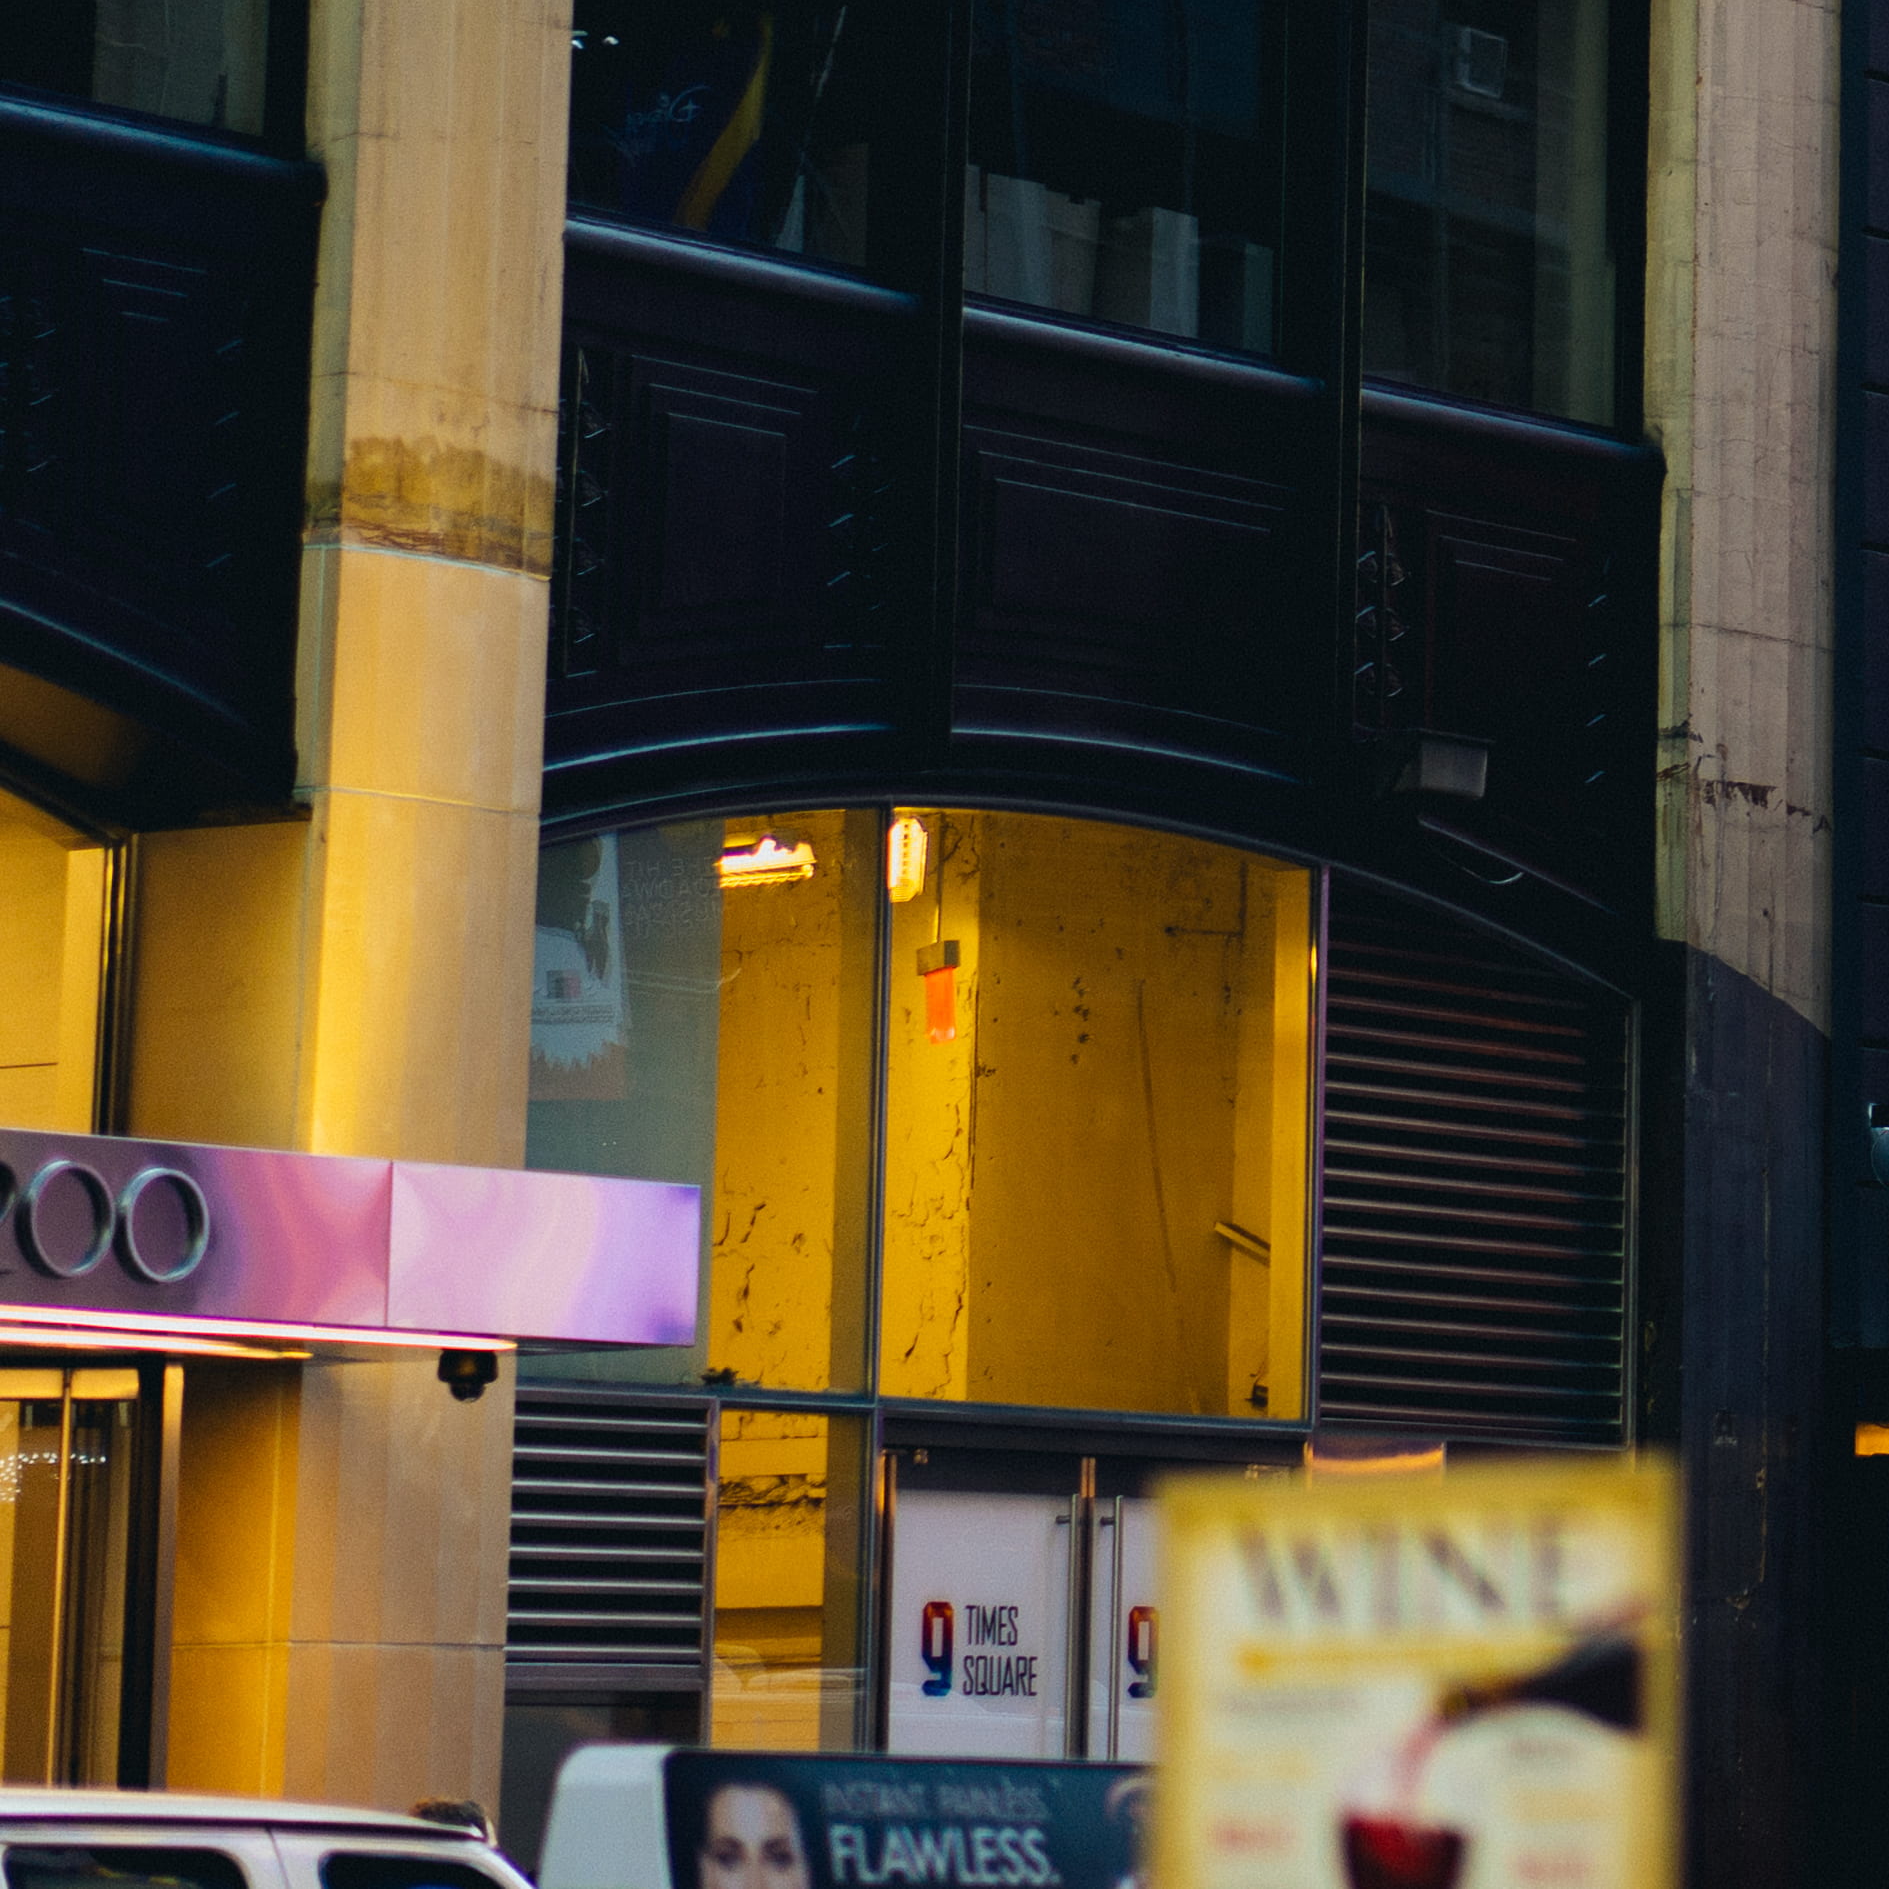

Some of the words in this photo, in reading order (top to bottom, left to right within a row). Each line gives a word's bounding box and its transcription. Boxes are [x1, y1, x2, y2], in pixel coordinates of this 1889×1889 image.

[0, 1160, 209, 1282] 00
[922, 1601, 953, 1696] 9
[965, 1605, 1018, 1646] TIMES
[962, 1656, 1038, 1696] SQUARE
[829, 1824, 1061, 1884] FLAWLESS.
